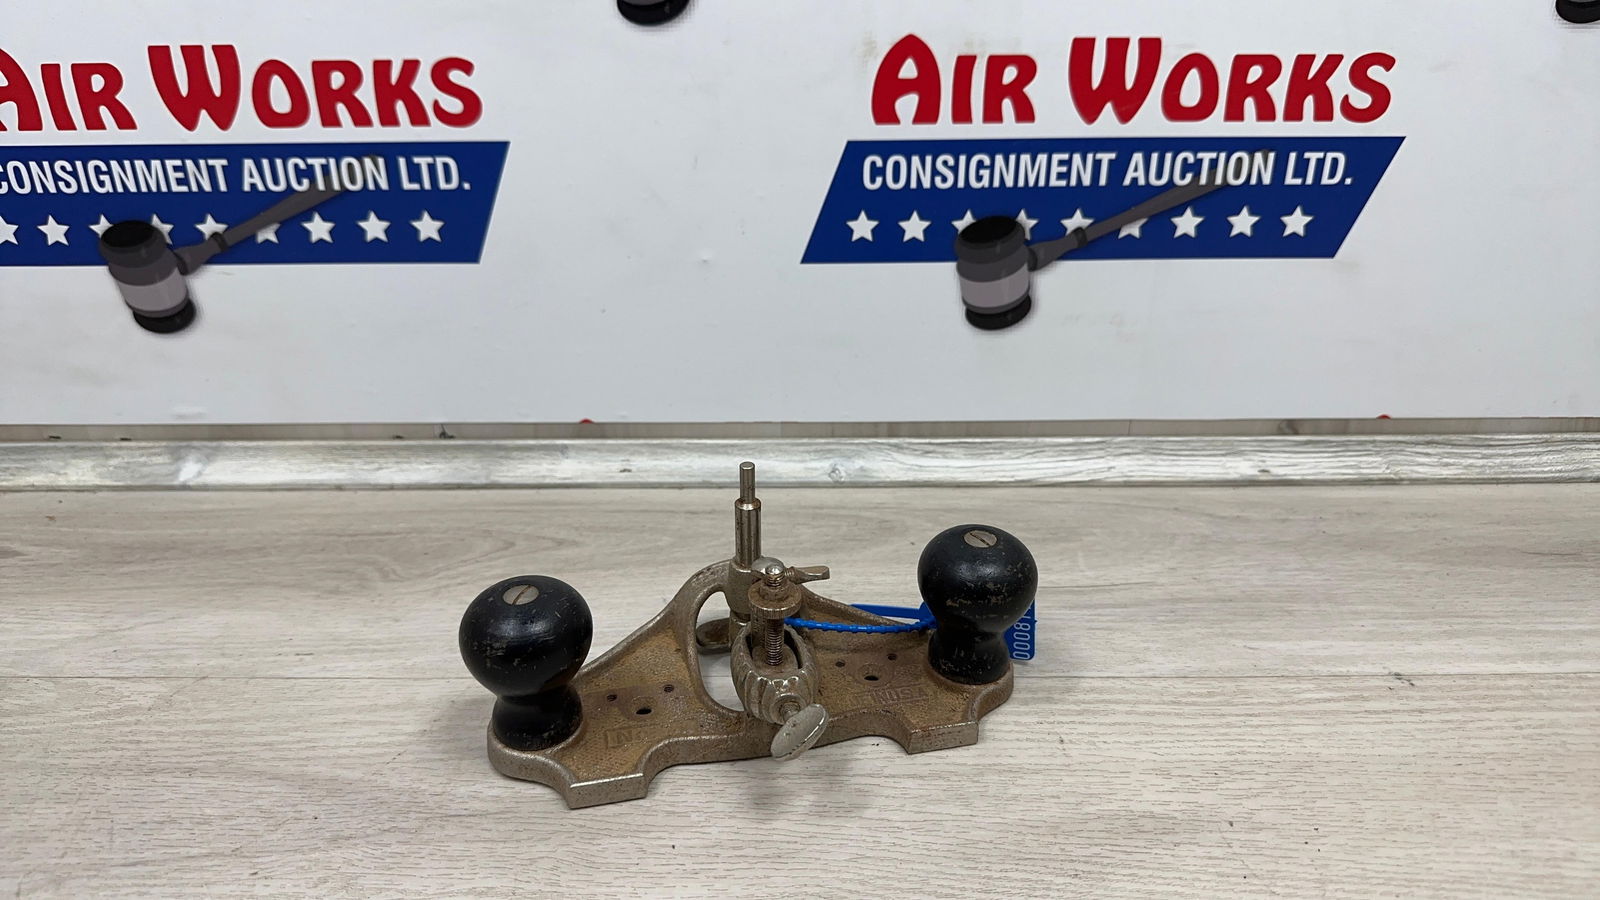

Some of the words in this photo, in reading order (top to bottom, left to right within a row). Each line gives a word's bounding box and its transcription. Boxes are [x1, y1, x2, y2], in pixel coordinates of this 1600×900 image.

[147, 44, 483, 132] WORKS
[871, 33, 1037, 126] AIR
[1068, 37, 1396, 125] WORKS
[241, 156, 388, 192] AUCTION
[401, 156, 472, 191] LTD.
[862, 152, 1116, 190] CONSIGNMENT
[1122, 151, 1276, 187] AUCTION
[1283, 152, 1354, 186] LTD.
